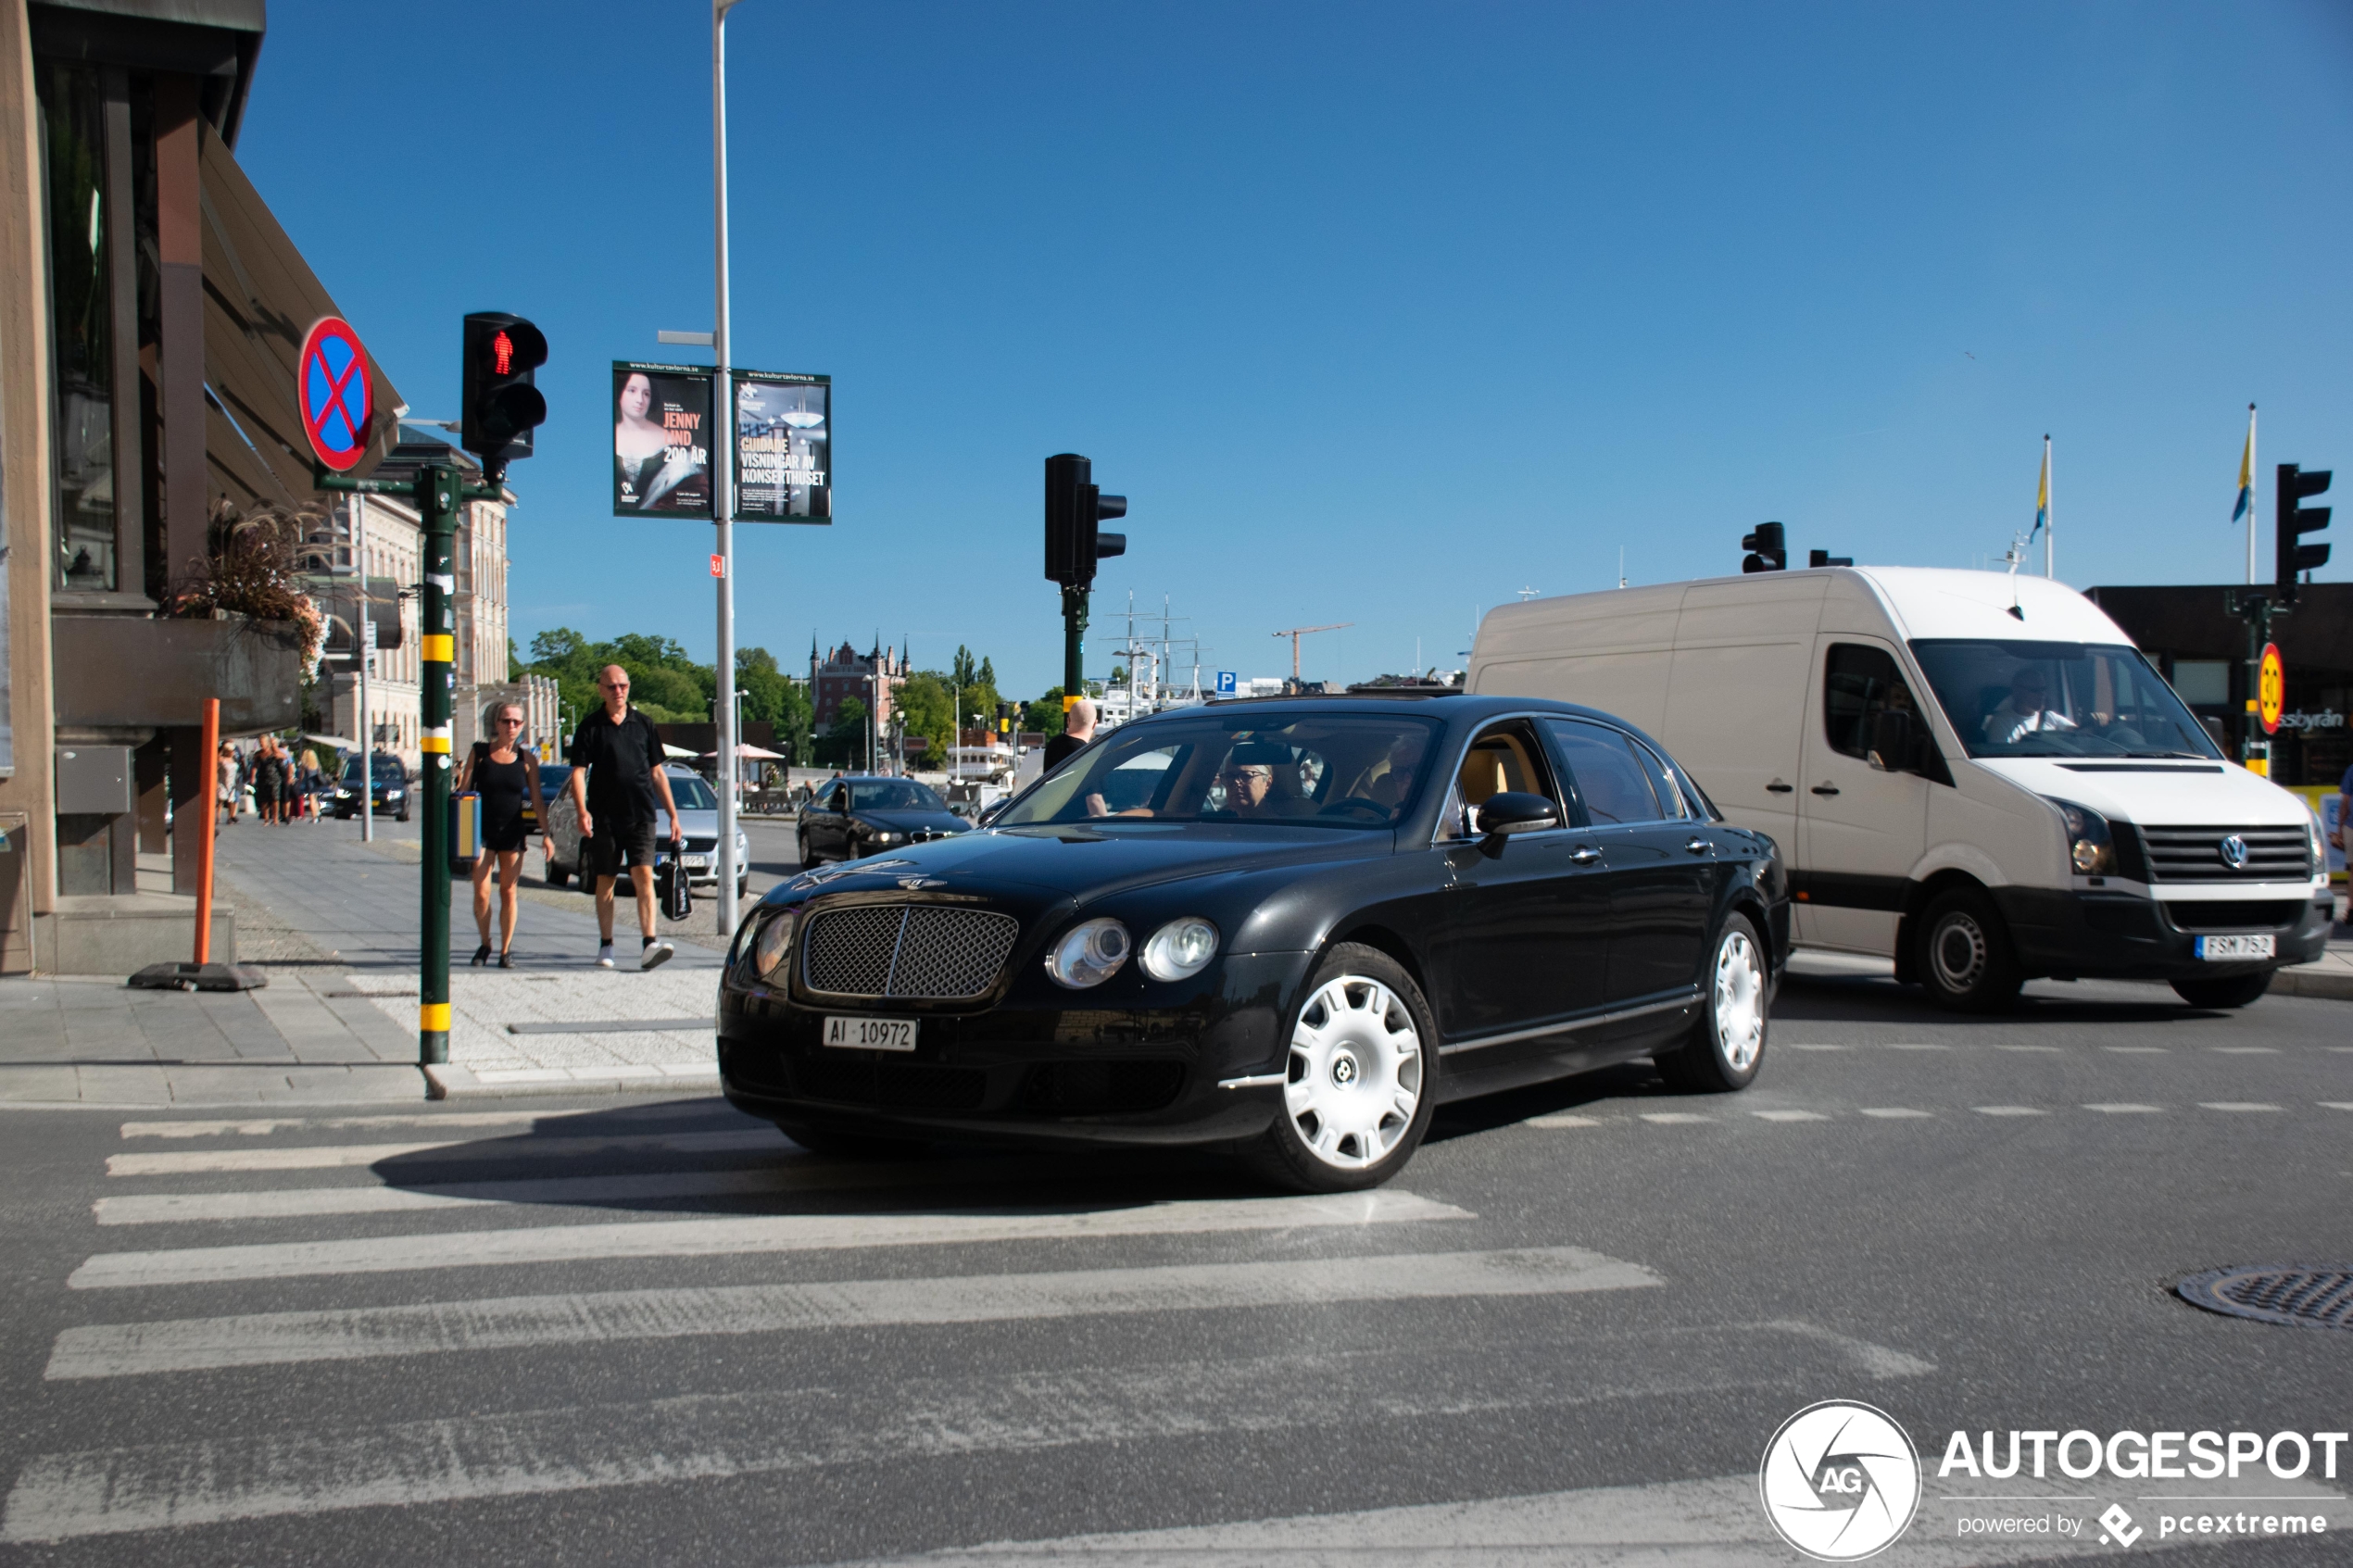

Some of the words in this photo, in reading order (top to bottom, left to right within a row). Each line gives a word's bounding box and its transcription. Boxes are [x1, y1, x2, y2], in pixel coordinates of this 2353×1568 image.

[629, 362, 699, 372] www.kulturtavlorna.se
[748, 371, 815, 382] www.kulturtavlorna.se
[662, 411, 701, 430] JENNY
[663, 429, 692, 445] LIND
[741, 437, 789, 453] GUIDADE
[663, 446, 687, 463] 200
[690, 445, 707, 464] ÅR
[741, 453, 799, 470] VISNINGAR
[802, 455, 816, 470] AV
[741, 468, 825, 486] KONSERTHUSET
[712, 560, 721, 573] 5,1
[1221, 672, 1234, 691] P
[2261, 668, 2279, 709] 30
[2208, 936, 2237, 955] FSM
[2242, 935, 2270, 954] 752
[860, 1021, 910, 1046] 10972
